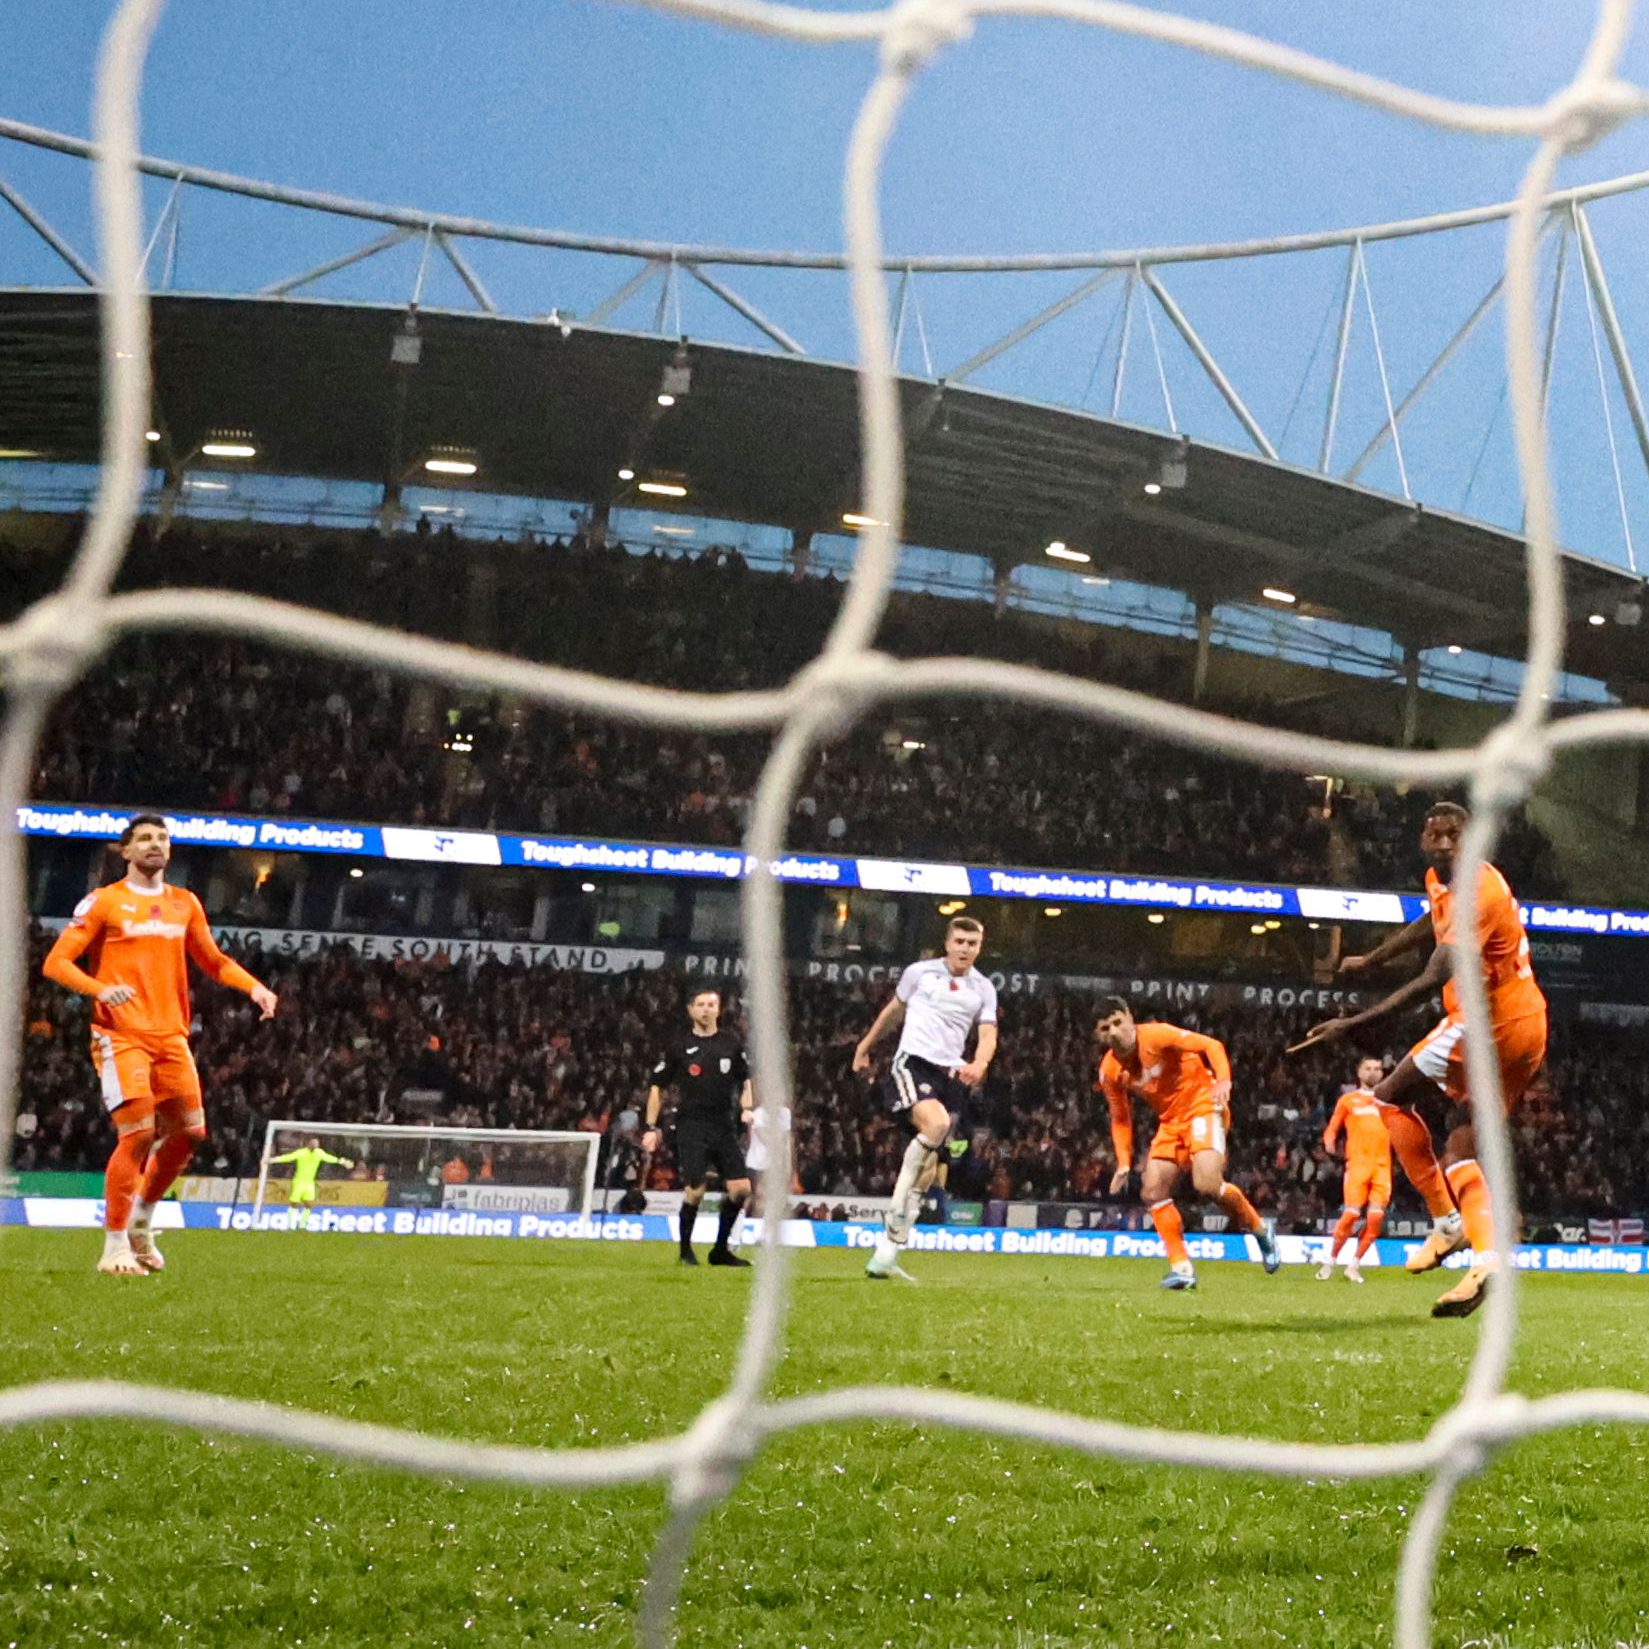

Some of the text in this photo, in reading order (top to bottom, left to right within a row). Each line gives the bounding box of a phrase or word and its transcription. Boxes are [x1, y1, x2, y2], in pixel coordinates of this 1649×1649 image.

[16, 807, 130, 835] Toughshe
[260, 823, 365, 850] Products
[521, 840, 840, 881] Toughsheet Building Poducts
[989, 872, 1283, 910] Toughsheet Building Products
[1531, 906, 1608, 932] Building
[684, 954, 752, 977] PRIN
[808, 961, 902, 983] PROCE
[473, 1189, 560, 1214] fabriplas
[393, 1211, 512, 1237] Building
[518, 1216, 644, 1240] Products
[843, 1225, 1225, 1258] Touhsheet Building Procts
[1546, 1247, 1641, 1273] Building
